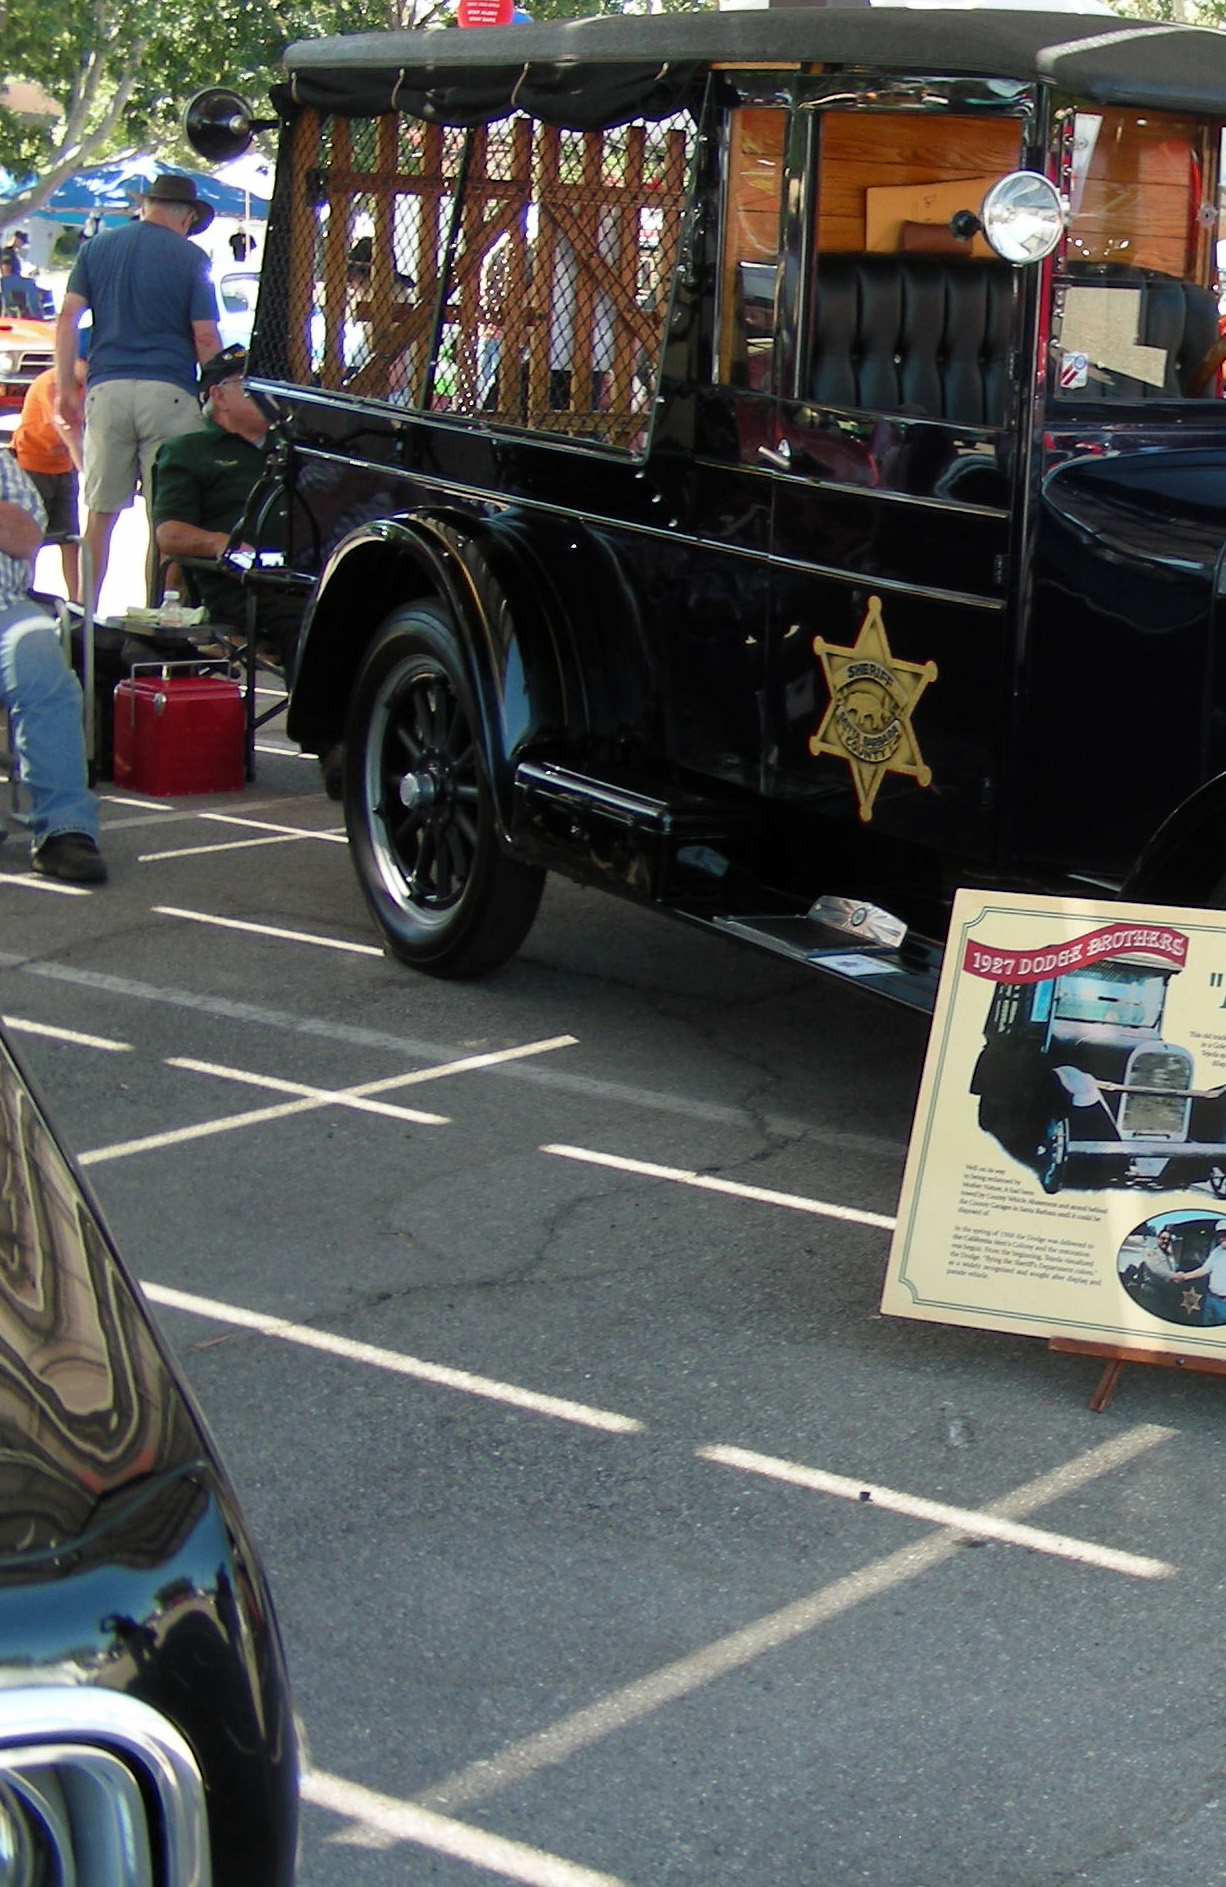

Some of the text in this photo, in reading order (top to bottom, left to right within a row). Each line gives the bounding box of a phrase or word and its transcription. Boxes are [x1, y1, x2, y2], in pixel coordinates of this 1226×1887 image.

[847, 663, 894, 687] SHERIFF
[972, 929, 1186, 976] 1927 DODGE BROTHERS
